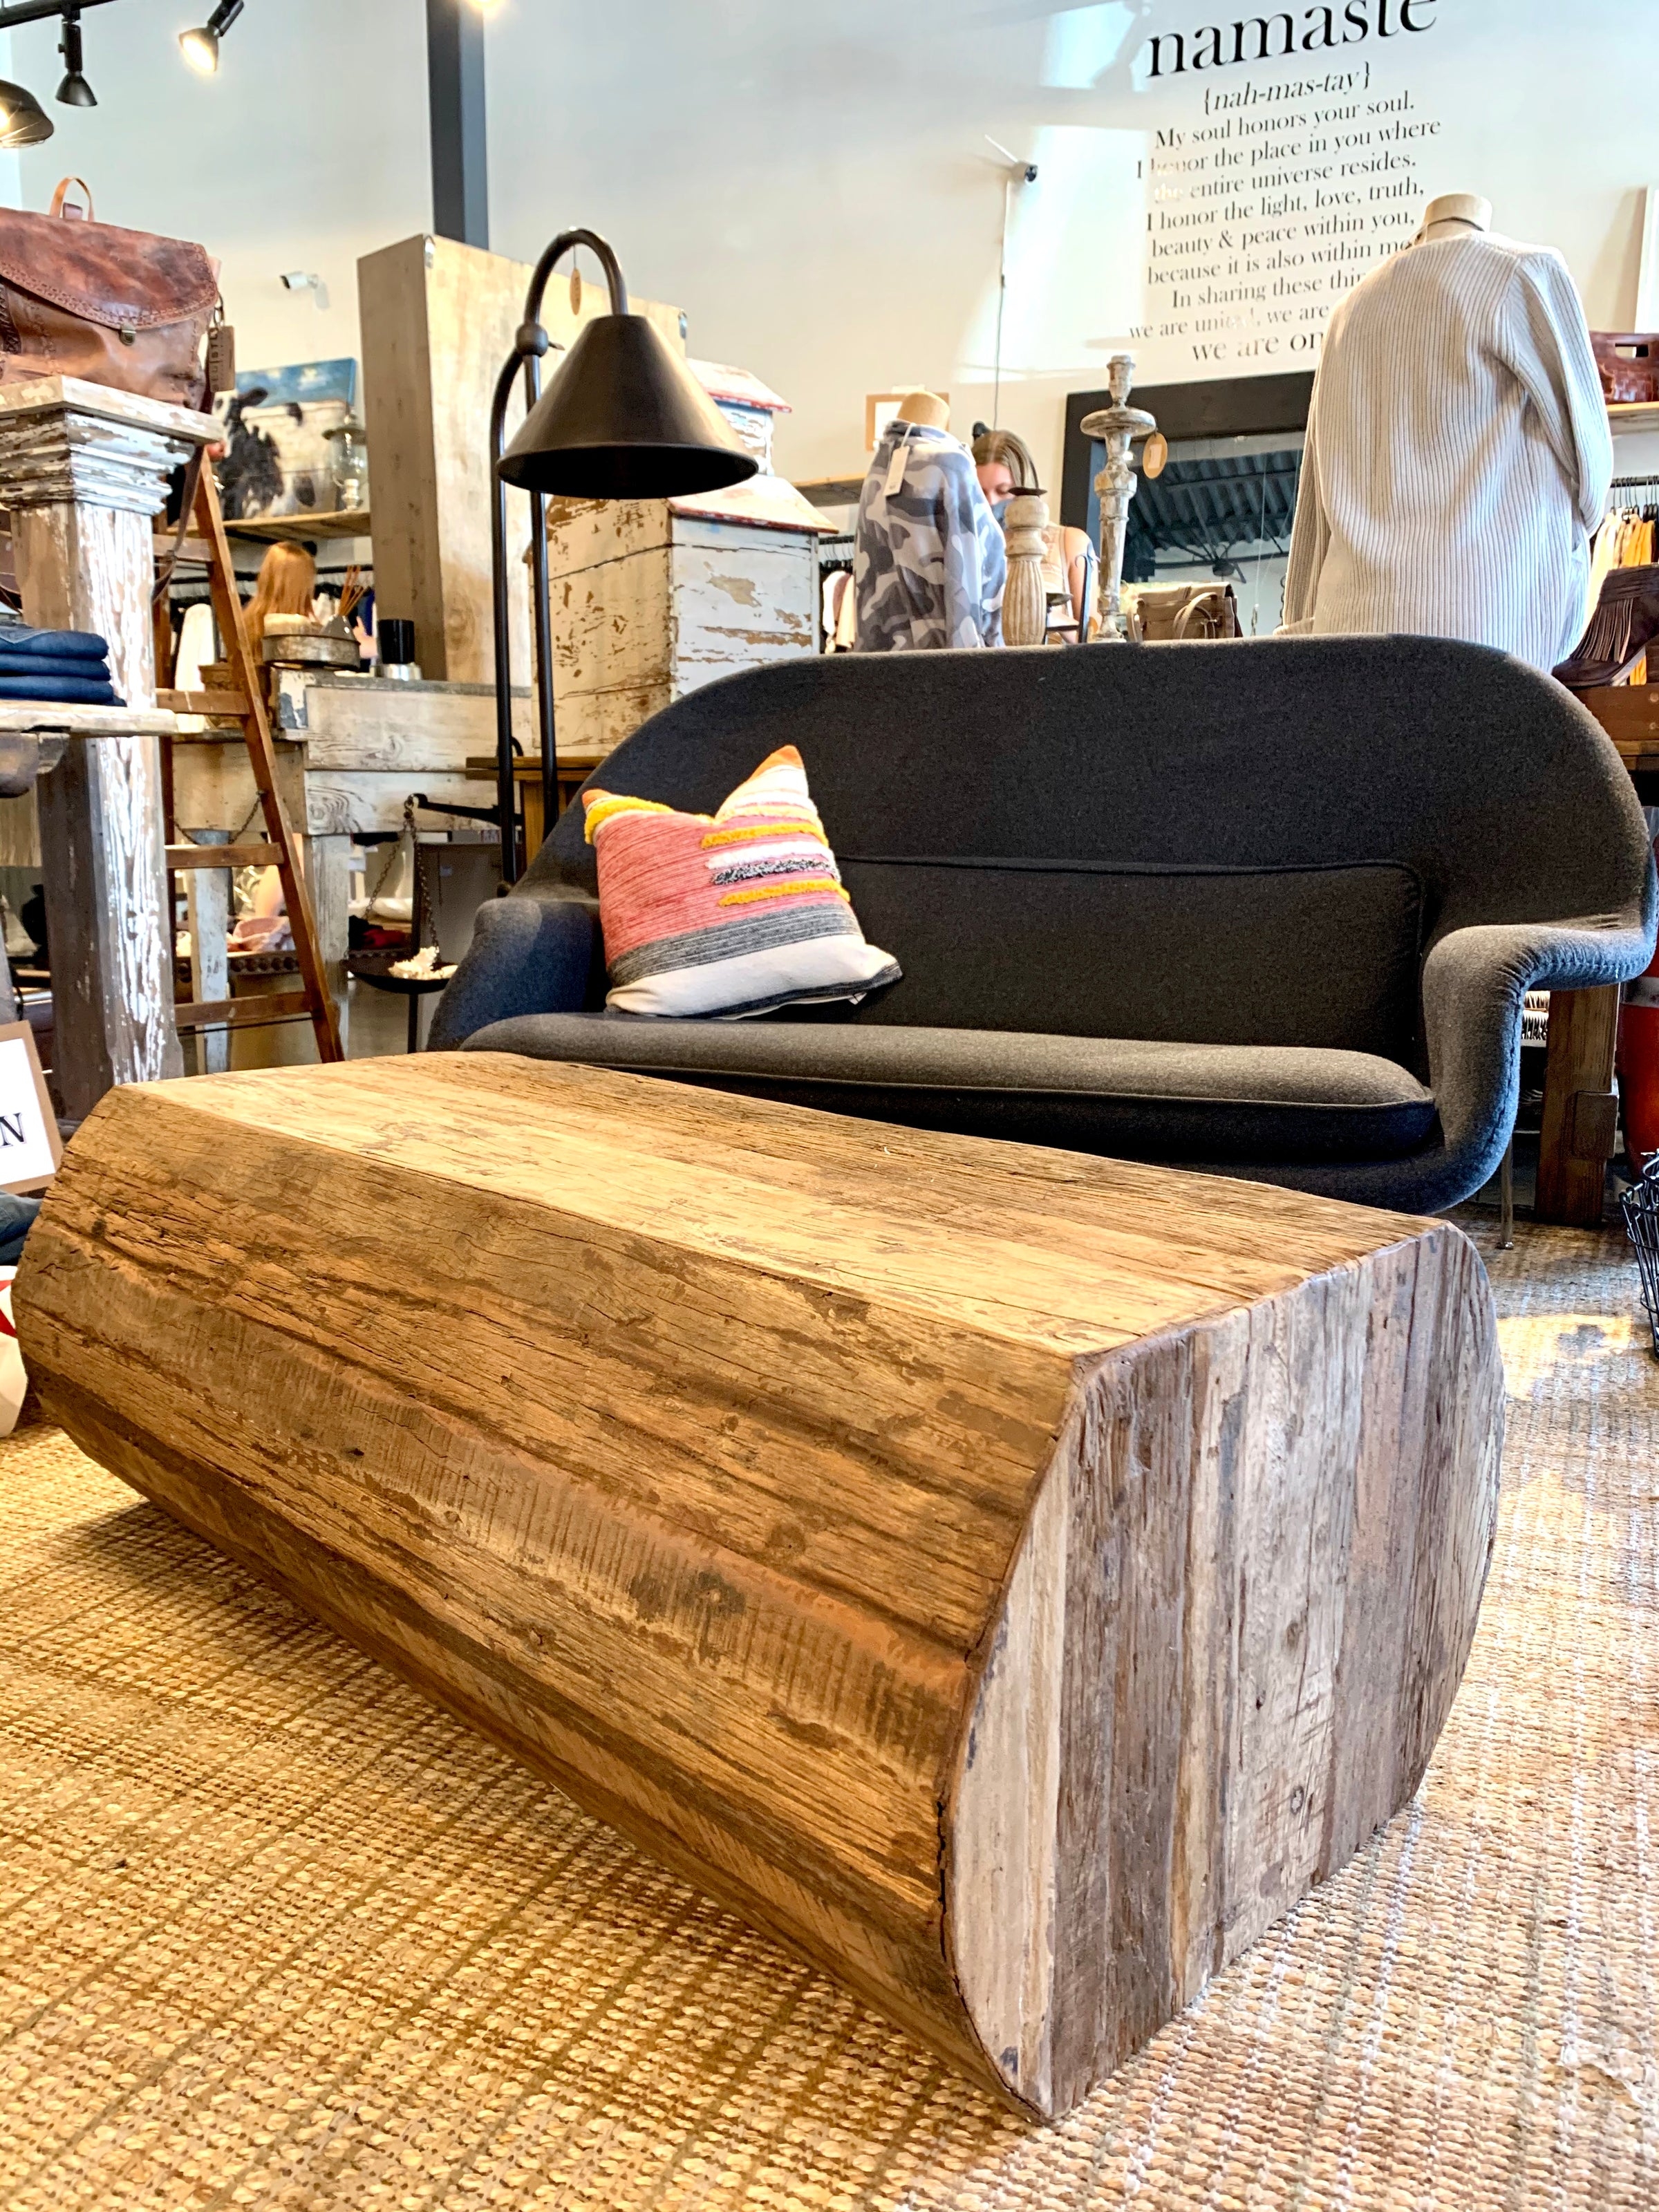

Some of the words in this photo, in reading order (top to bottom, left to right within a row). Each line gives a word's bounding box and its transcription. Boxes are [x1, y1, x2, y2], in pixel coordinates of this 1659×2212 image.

[1145, 0, 1437, 77] namaste
[1203, 61, 1371, 115] {nah-mas-tay}
[1155, 127, 1185, 151] My
[1192, 118, 1230, 144] soul
[1238, 113, 1307, 137] honors
[1313, 104, 1360, 129] your
[1366, 90, 1414, 116] soul.
[1136, 160, 1142, 179] I
[1215, 147, 1244, 168] the
[1250, 140, 1302, 167] place
[1309, 133, 1327, 153] in
[1334, 131, 1371, 154] you
[1379, 120, 1441, 141] where
[1190, 174, 1244, 198] entire
[1251, 165, 1333, 190] universe
[1341, 151, 1416, 177] resides.
[1147, 212, 1152, 232] I
[1160, 209, 1218, 230] honor
[1224, 200, 1253, 221] the
[1262, 193, 1307, 218] light,
[1315, 188, 1362, 209] love,
[1369, 176, 1424, 201] truth,
[1152, 236, 1212, 258] beauty
[1219, 229, 1234, 249] &
[1241, 225, 1297, 250] peace
[1304, 212, 1364, 236] within
[1371, 210, 1415, 234] you,
[1148, 263, 1221, 285] because
[1228, 255, 1239, 275] it
[1246, 253, 1260, 273] is
[1266, 249, 1304, 270] also
[1311, 238, 1371, 263] within
[1172, 289, 1191, 308] In
[1198, 281, 1266, 306] sharing
[1273, 276, 1322, 297] these
[1129, 324, 1154, 339] we
[1159, 319, 1188, 337] are
[1267, 308, 1293, 324] we
[1299, 304, 1329, 321] are
[1191, 341, 1226, 362] we
[1237, 335, 1280, 358] are
